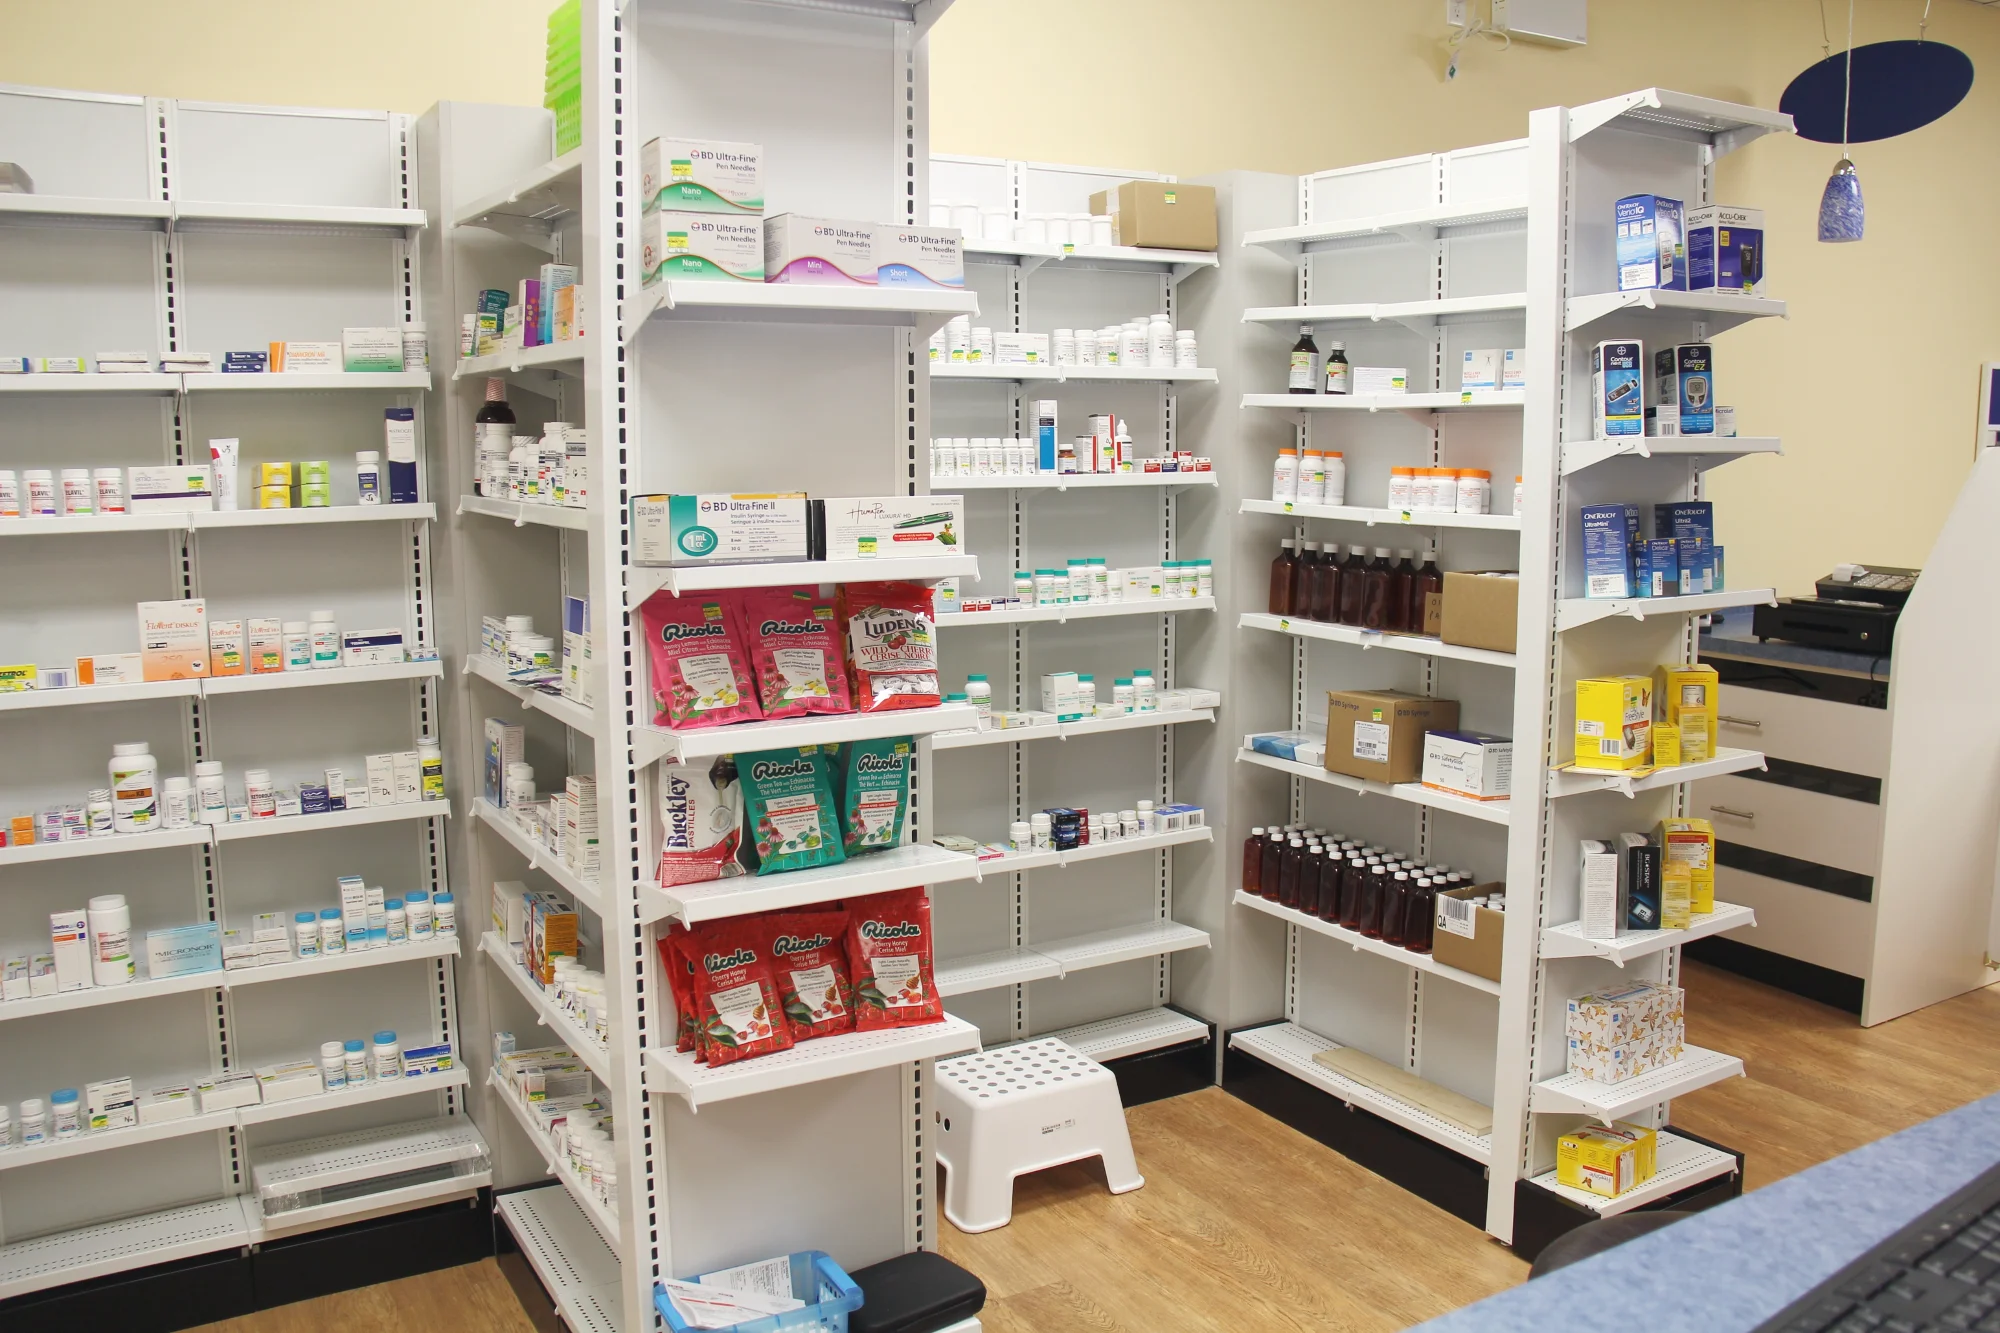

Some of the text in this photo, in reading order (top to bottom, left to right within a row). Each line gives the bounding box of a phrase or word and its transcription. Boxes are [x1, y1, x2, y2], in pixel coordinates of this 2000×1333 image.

[701, 151, 756, 163] BD Ultra-Fine
[730, 164, 756, 172] Needles
[681, 186, 701, 194] Nano
[1688, 214, 1713, 222] ACCU-CHEK
[1718, 212, 1746, 221] ACCU-CHEK
[701, 223, 756, 234] BD Ultra-Fine
[823, 228, 870, 240] BD Ultra-Fine
[849, 240, 870, 248] Needles
[908, 235, 956, 246] BD Ultra-Fine
[682, 259, 702, 267] Nano
[807, 261, 822, 269] Mini
[890, 268, 908, 277] Short
[713, 502, 775, 511] BD Ultra-Fine II
[688, 534, 707, 548] 1 mL
[146, 621, 173, 630] Flovent
[760, 619, 825, 636] Ricola
[662, 622, 726, 642] Ricola
[861, 646, 888, 655] WILD
[1342, 702, 1359, 711] Syringe
[857, 753, 903, 773] Ricola
[752, 759, 815, 781] Ricola
[666, 775, 690, 848] Buckley
[1438, 915, 1446, 928] QA
[861, 920, 921, 939] Ricola
[158, 944, 213, 956] MICRONOR
[712, 968, 746, 982] Cherry Honey
[717, 975, 746, 988] Cerise Miel
